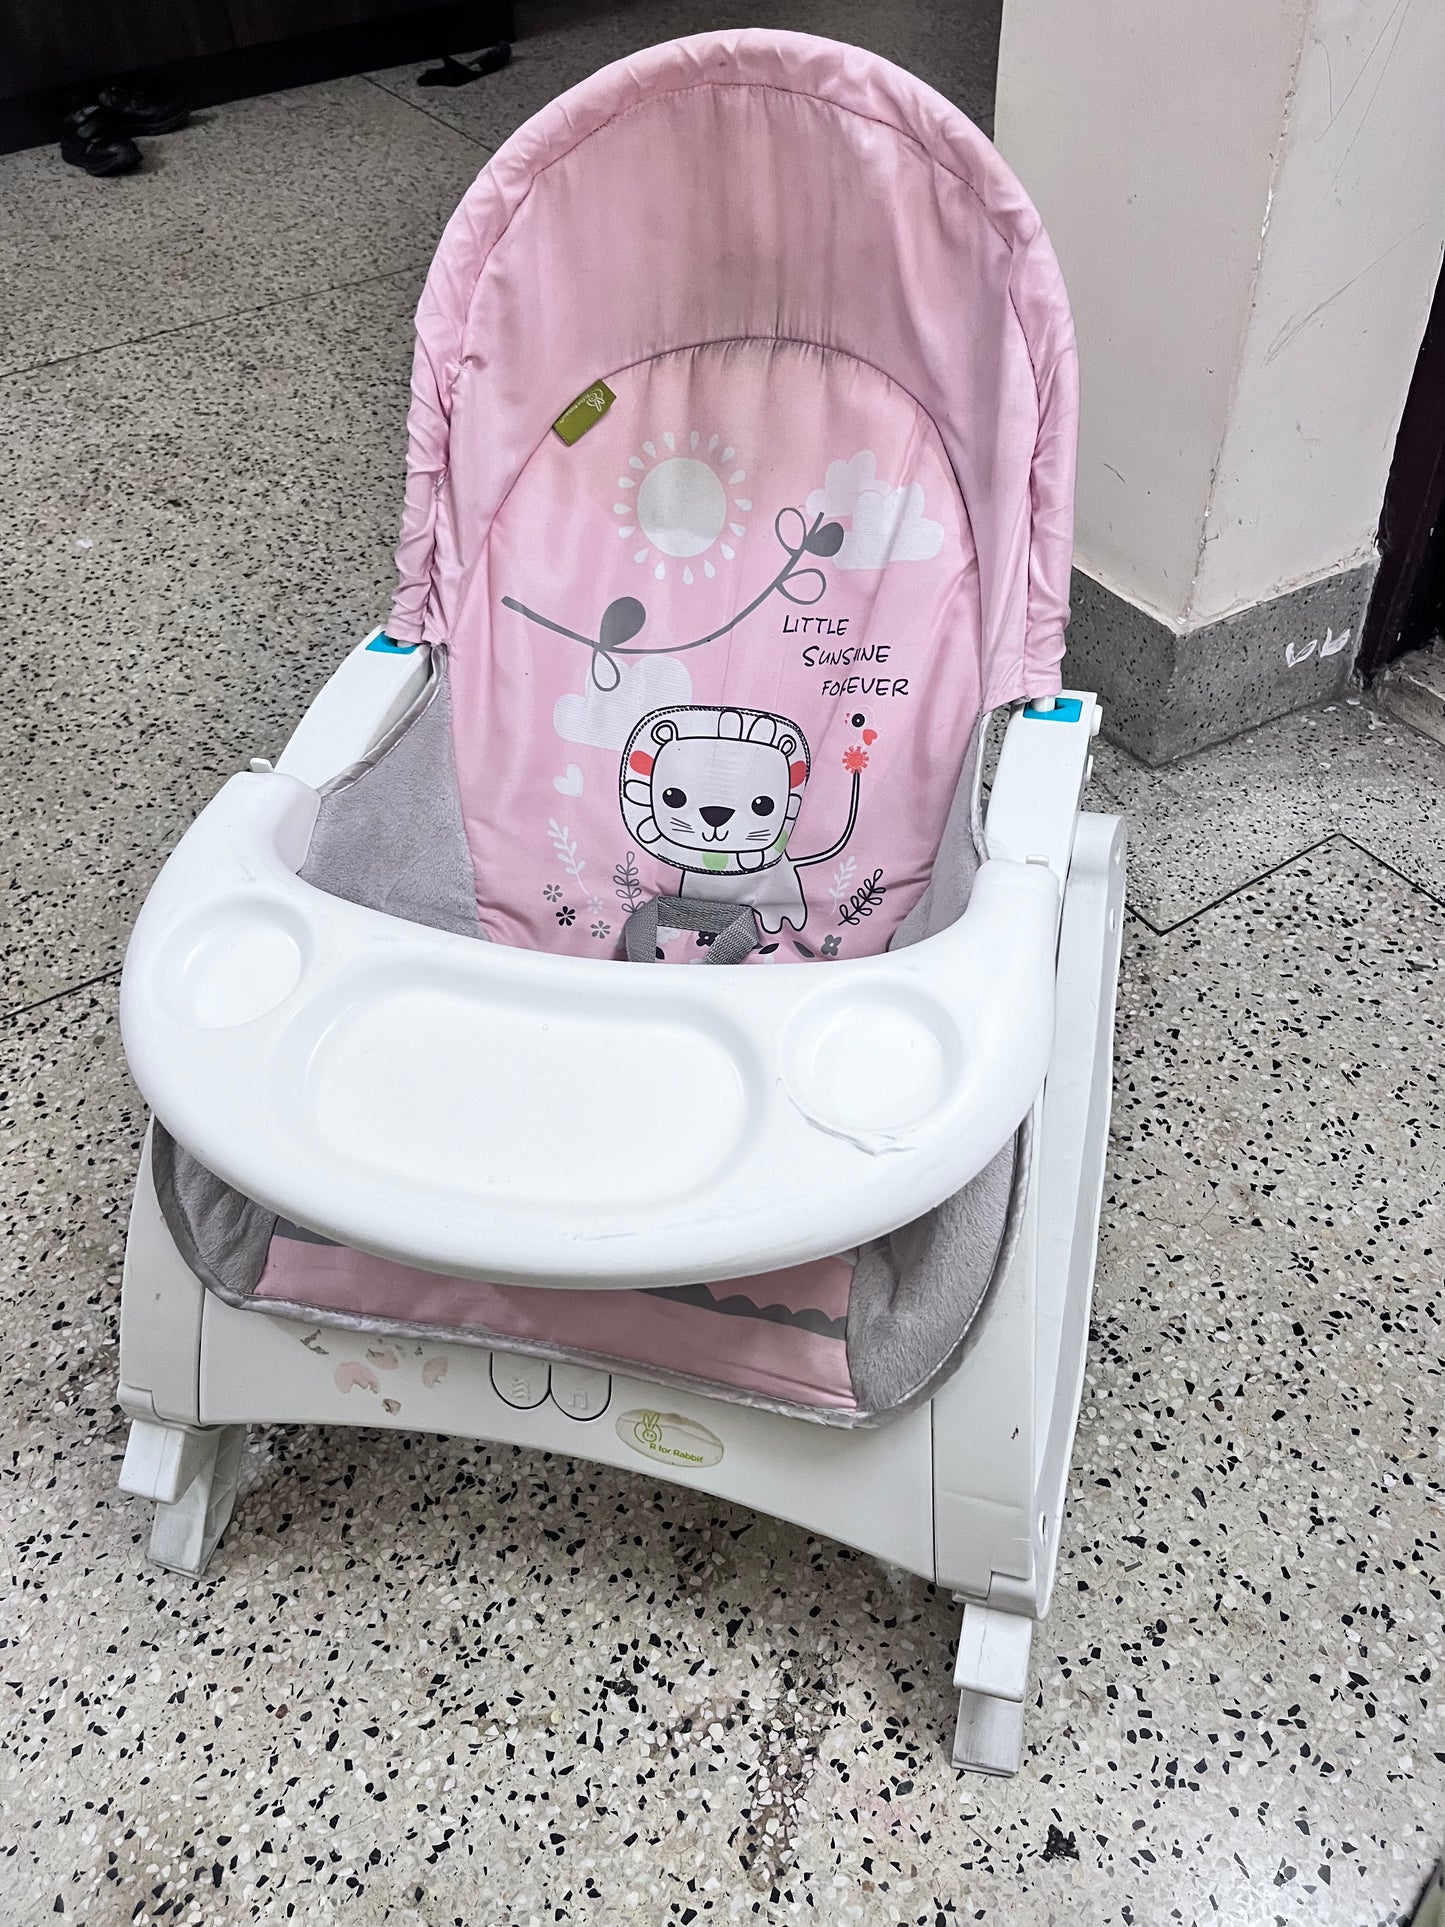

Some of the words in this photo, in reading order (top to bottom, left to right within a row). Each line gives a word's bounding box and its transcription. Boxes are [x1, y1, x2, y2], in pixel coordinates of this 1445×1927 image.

[782, 615, 849, 636] LITTLE
[649, 1442, 657, 1451] R
[658, 1445, 671, 1455] for
